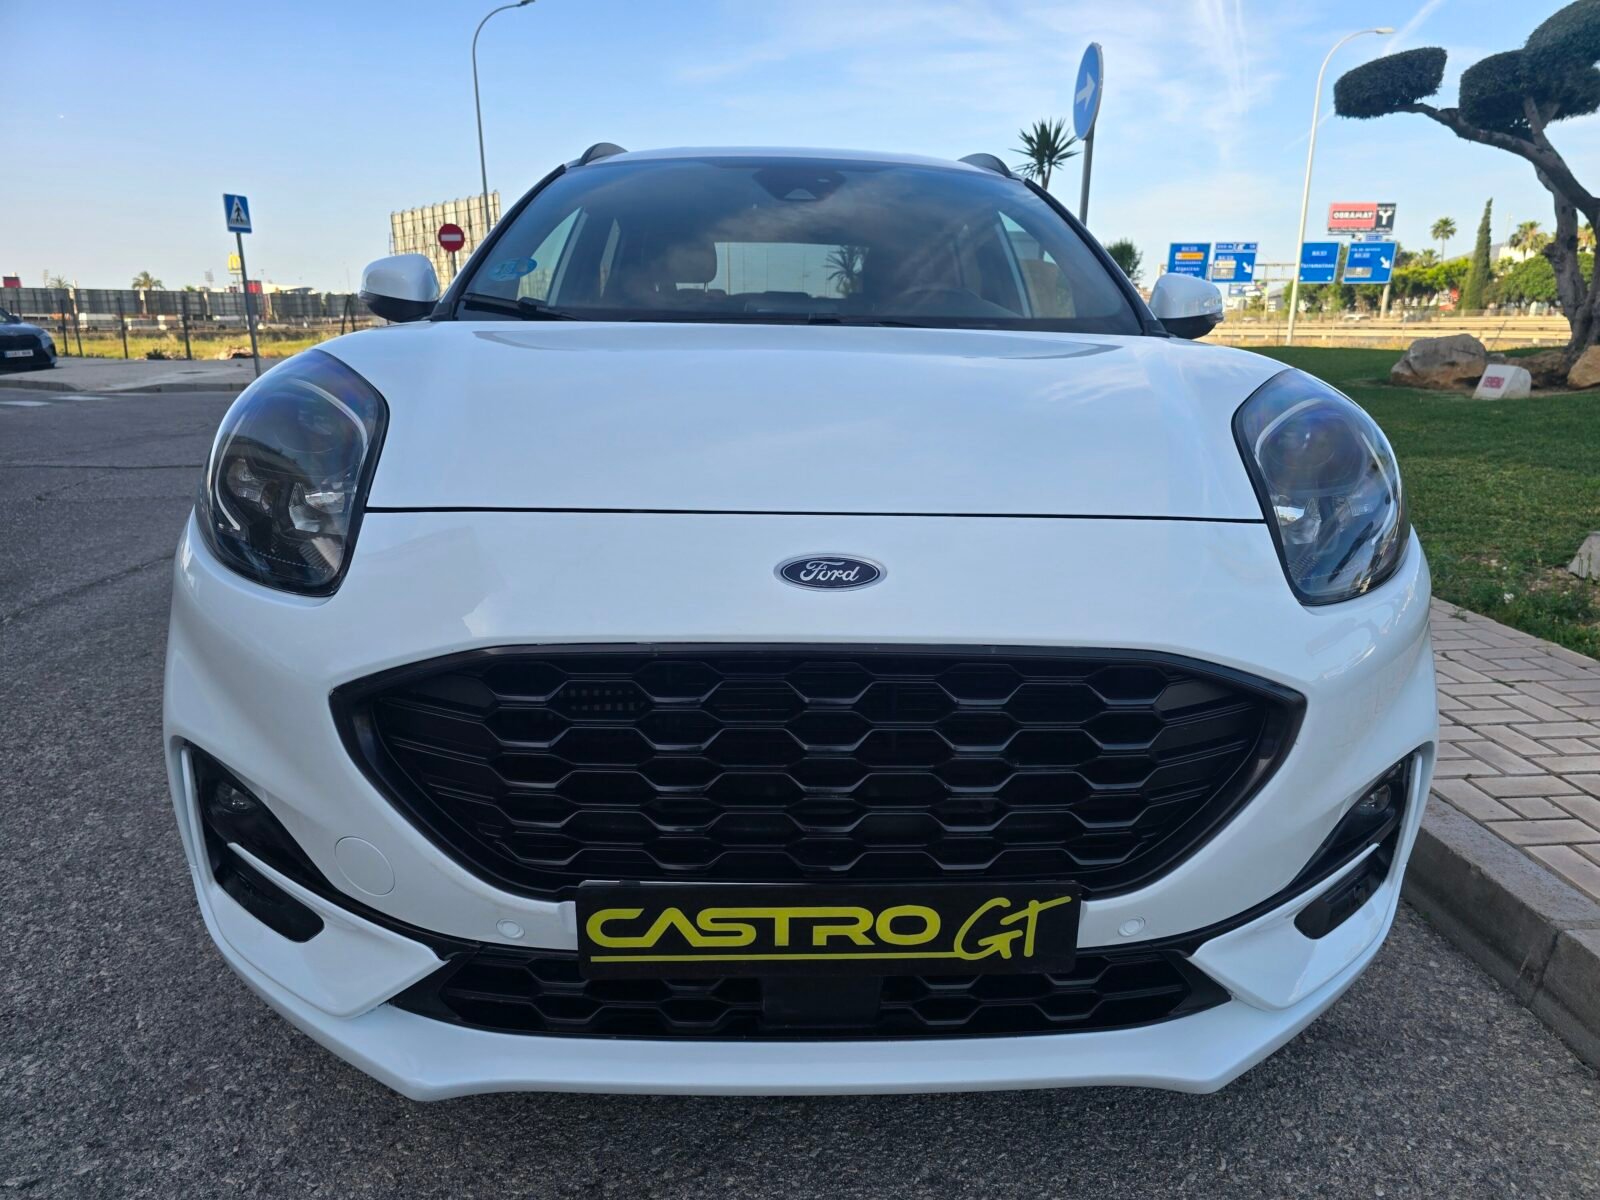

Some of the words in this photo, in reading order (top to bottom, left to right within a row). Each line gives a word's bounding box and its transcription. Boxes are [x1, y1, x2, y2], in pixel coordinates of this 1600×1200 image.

[1333, 212, 1374, 220] OBRAMAT
[799, 560, 861, 582] Ford
[586, 905, 941, 948] CASTRO
[953, 896, 1073, 960] GT
